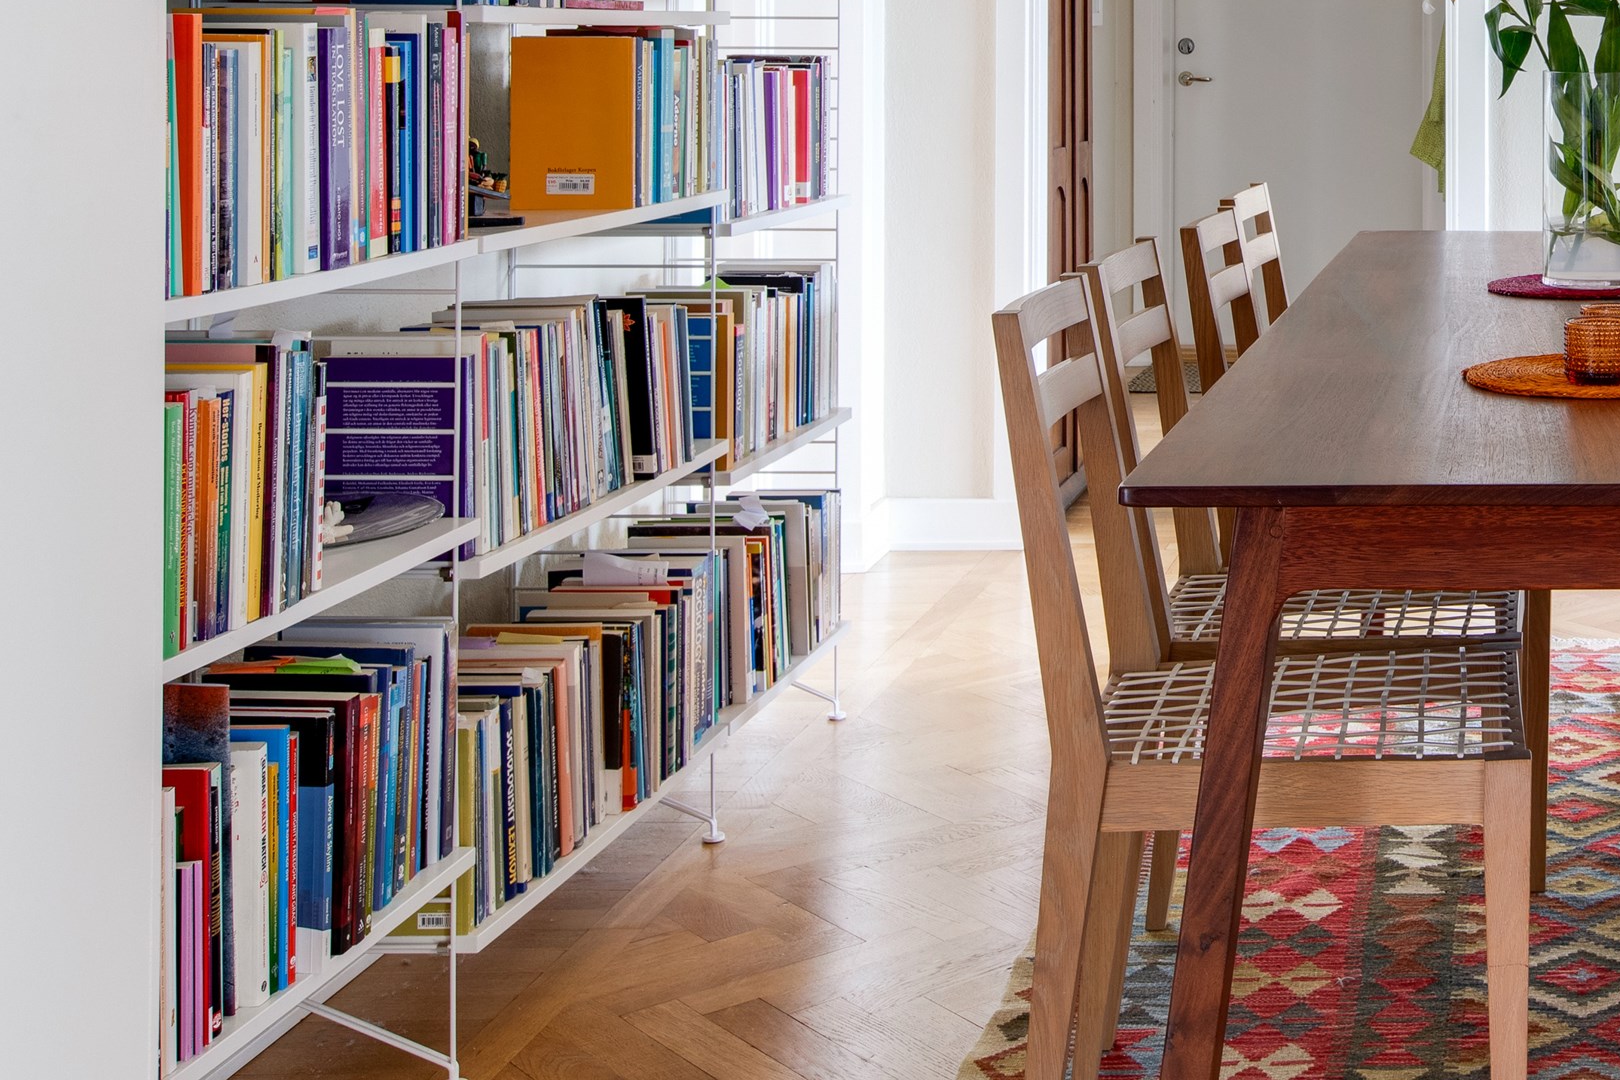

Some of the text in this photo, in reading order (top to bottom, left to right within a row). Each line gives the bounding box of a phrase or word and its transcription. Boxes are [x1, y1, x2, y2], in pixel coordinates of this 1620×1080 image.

[331, 44, 337, 59] IN
[336, 43, 346, 148] LOVE LOST
[673, 93, 681, 146] Adorno
[734, 351, 744, 411] Sociology
[220, 398, 231, 463] Her-stories
[292, 412, 303, 487] Discipleship
[186, 407, 198, 537] Kvinnor som murbräckor
[291, 508, 300, 551] Equals
[179, 521, 187, 608] KVINNOHISTORIER
[694, 577, 703, 664] SOCIOLOGY
[326, 794, 334, 823] Above
[506, 729, 518, 885] SOCIOLOGISKT LEXIKON
[325, 840, 333, 873] Skyline
[211, 893, 221, 937] KVINNA
